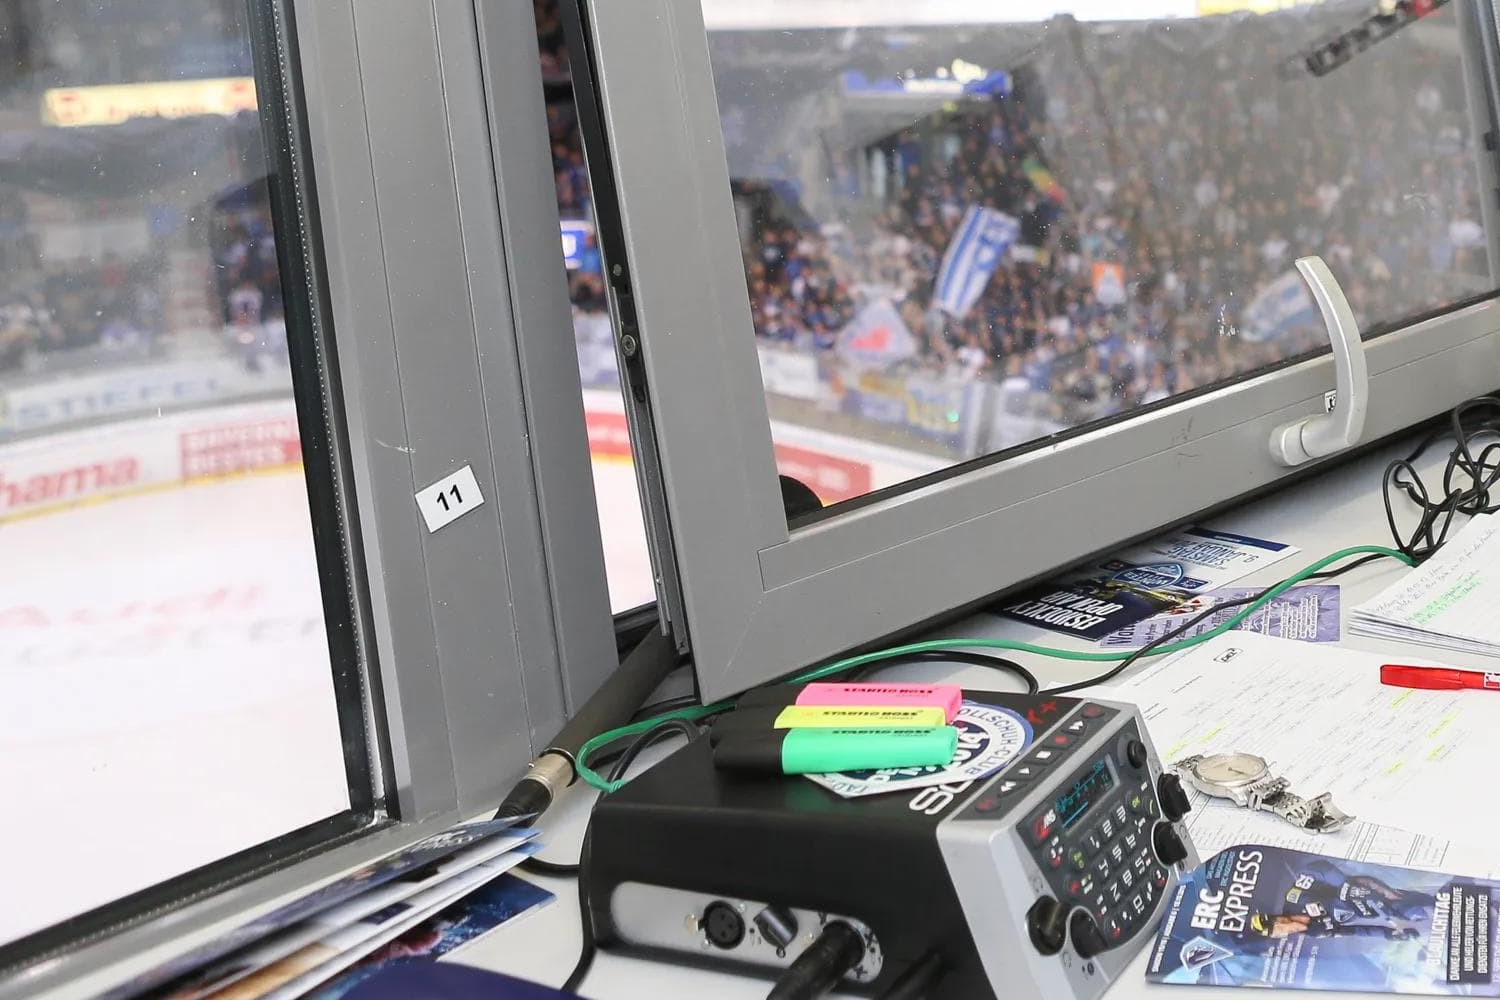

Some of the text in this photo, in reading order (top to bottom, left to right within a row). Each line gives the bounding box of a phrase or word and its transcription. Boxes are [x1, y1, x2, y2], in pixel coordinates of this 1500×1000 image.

[436, 485, 465, 511] 11
[1003, 601, 1106, 630] EISHOCKEY
[1040, 591, 1124, 616] OPEN AIR
[1219, 850, 1263, 932] EXPRESS
[1190, 888, 1224, 930] ERC
